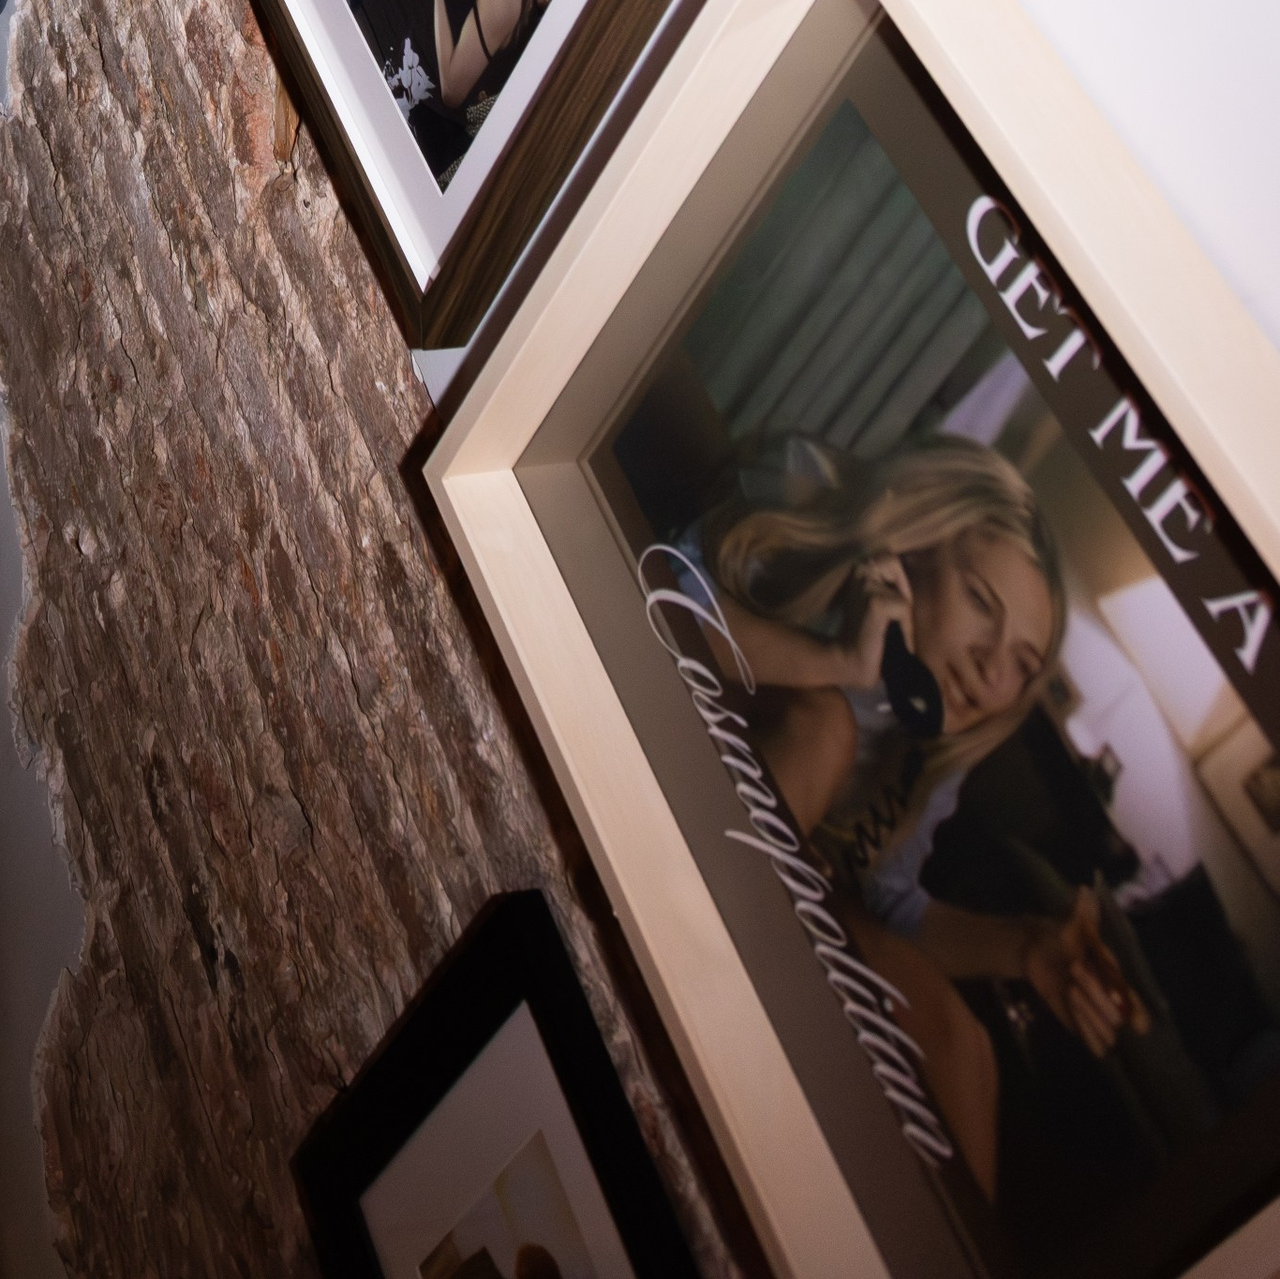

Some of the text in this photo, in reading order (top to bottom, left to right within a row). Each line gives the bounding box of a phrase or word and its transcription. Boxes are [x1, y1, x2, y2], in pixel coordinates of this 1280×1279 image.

[965, 194, 1276, 675] GET ME A
[637, 543, 953, 1168] Cosmopolitan
